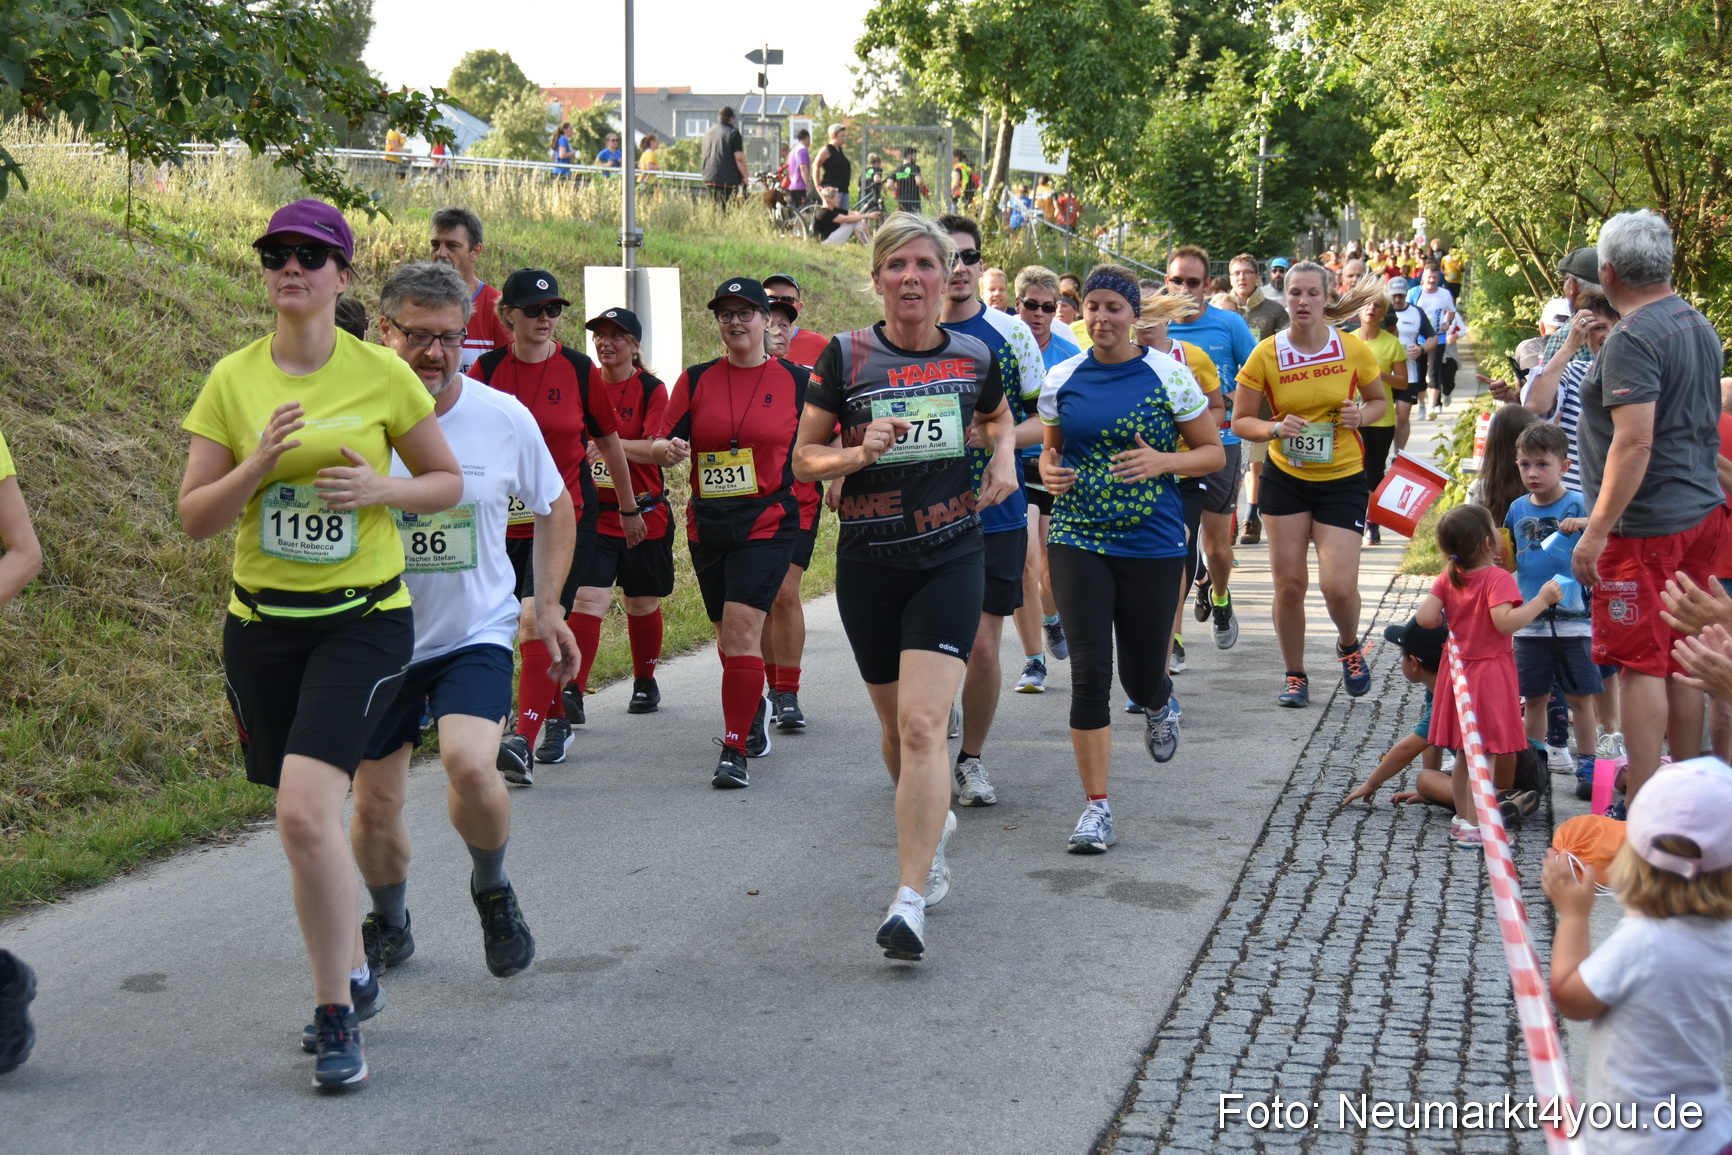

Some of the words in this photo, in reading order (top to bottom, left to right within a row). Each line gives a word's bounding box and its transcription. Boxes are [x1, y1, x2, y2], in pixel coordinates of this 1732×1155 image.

[887, 358, 978, 387] HAARE
[1279, 371, 1309, 385] MAX
[1313, 365, 1347, 378] BÖGL
[548, 389, 561, 401] 21
[764, 394, 772, 403] 8
[621, 408, 634, 418] 24
[892, 444, 927, 452] Steinmann
[1289, 436, 1324, 452] 1631
[704, 466, 745, 485] 2331
[1407, 505, 1418, 519] DEHN
[271, 510, 344, 542] 1198
[453, 521, 471, 529] 2019
[277, 538, 299, 548] Bauer
[300, 541, 334, 551] Rebecca
[411, 530, 447, 555] 86
[281, 546, 302, 555] Klinikum
[303, 548, 329, 557] Neumarkt
[404, 555, 431, 563] Fischer
[432, 554, 456, 562] Stefan
[938, 643, 959, 654] adidas
